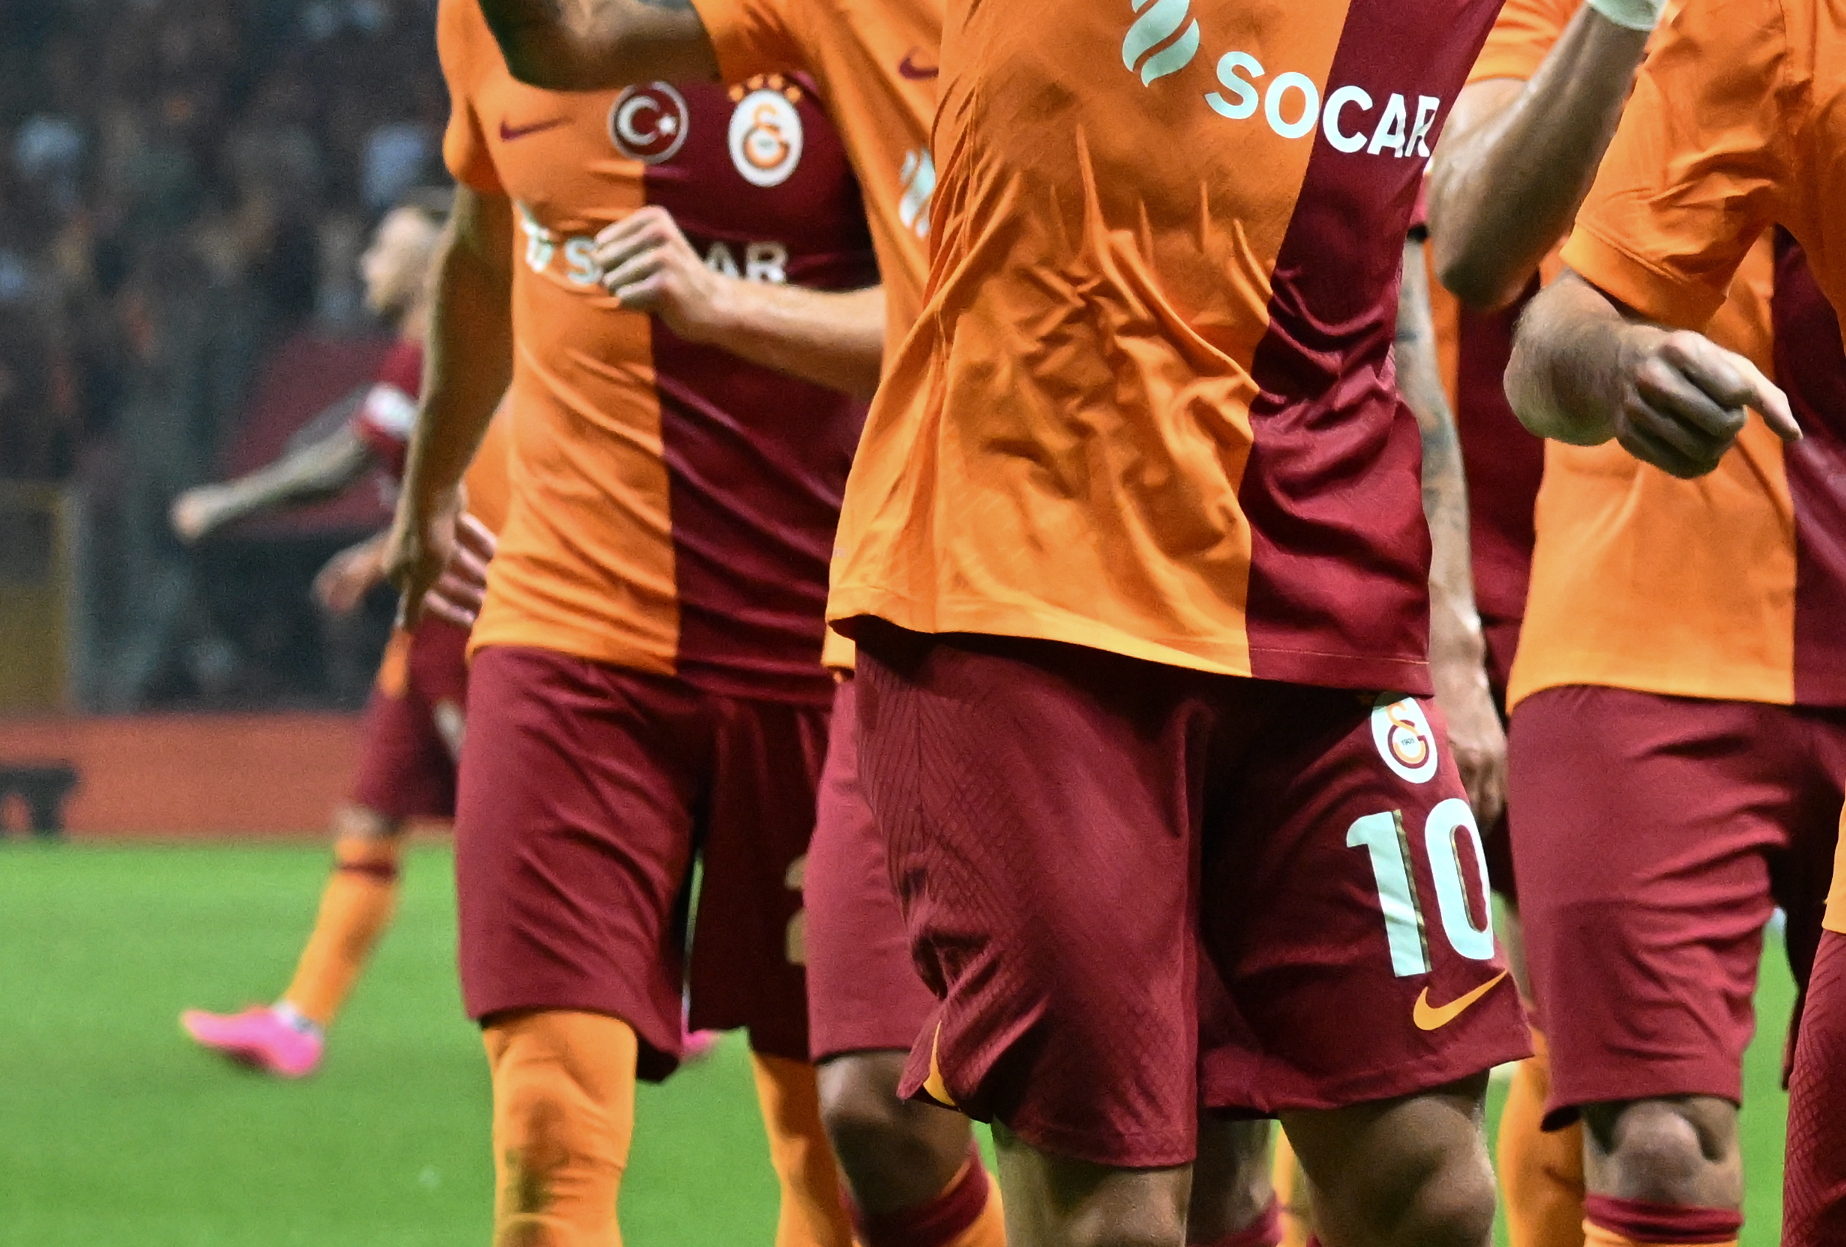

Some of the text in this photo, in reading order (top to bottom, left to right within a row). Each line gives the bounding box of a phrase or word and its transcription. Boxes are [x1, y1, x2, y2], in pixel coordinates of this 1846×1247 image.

[1204, 51, 1440, 158] SOCAR
[564, 235, 788, 285] SAR
[1345, 797, 1496, 979] 10
